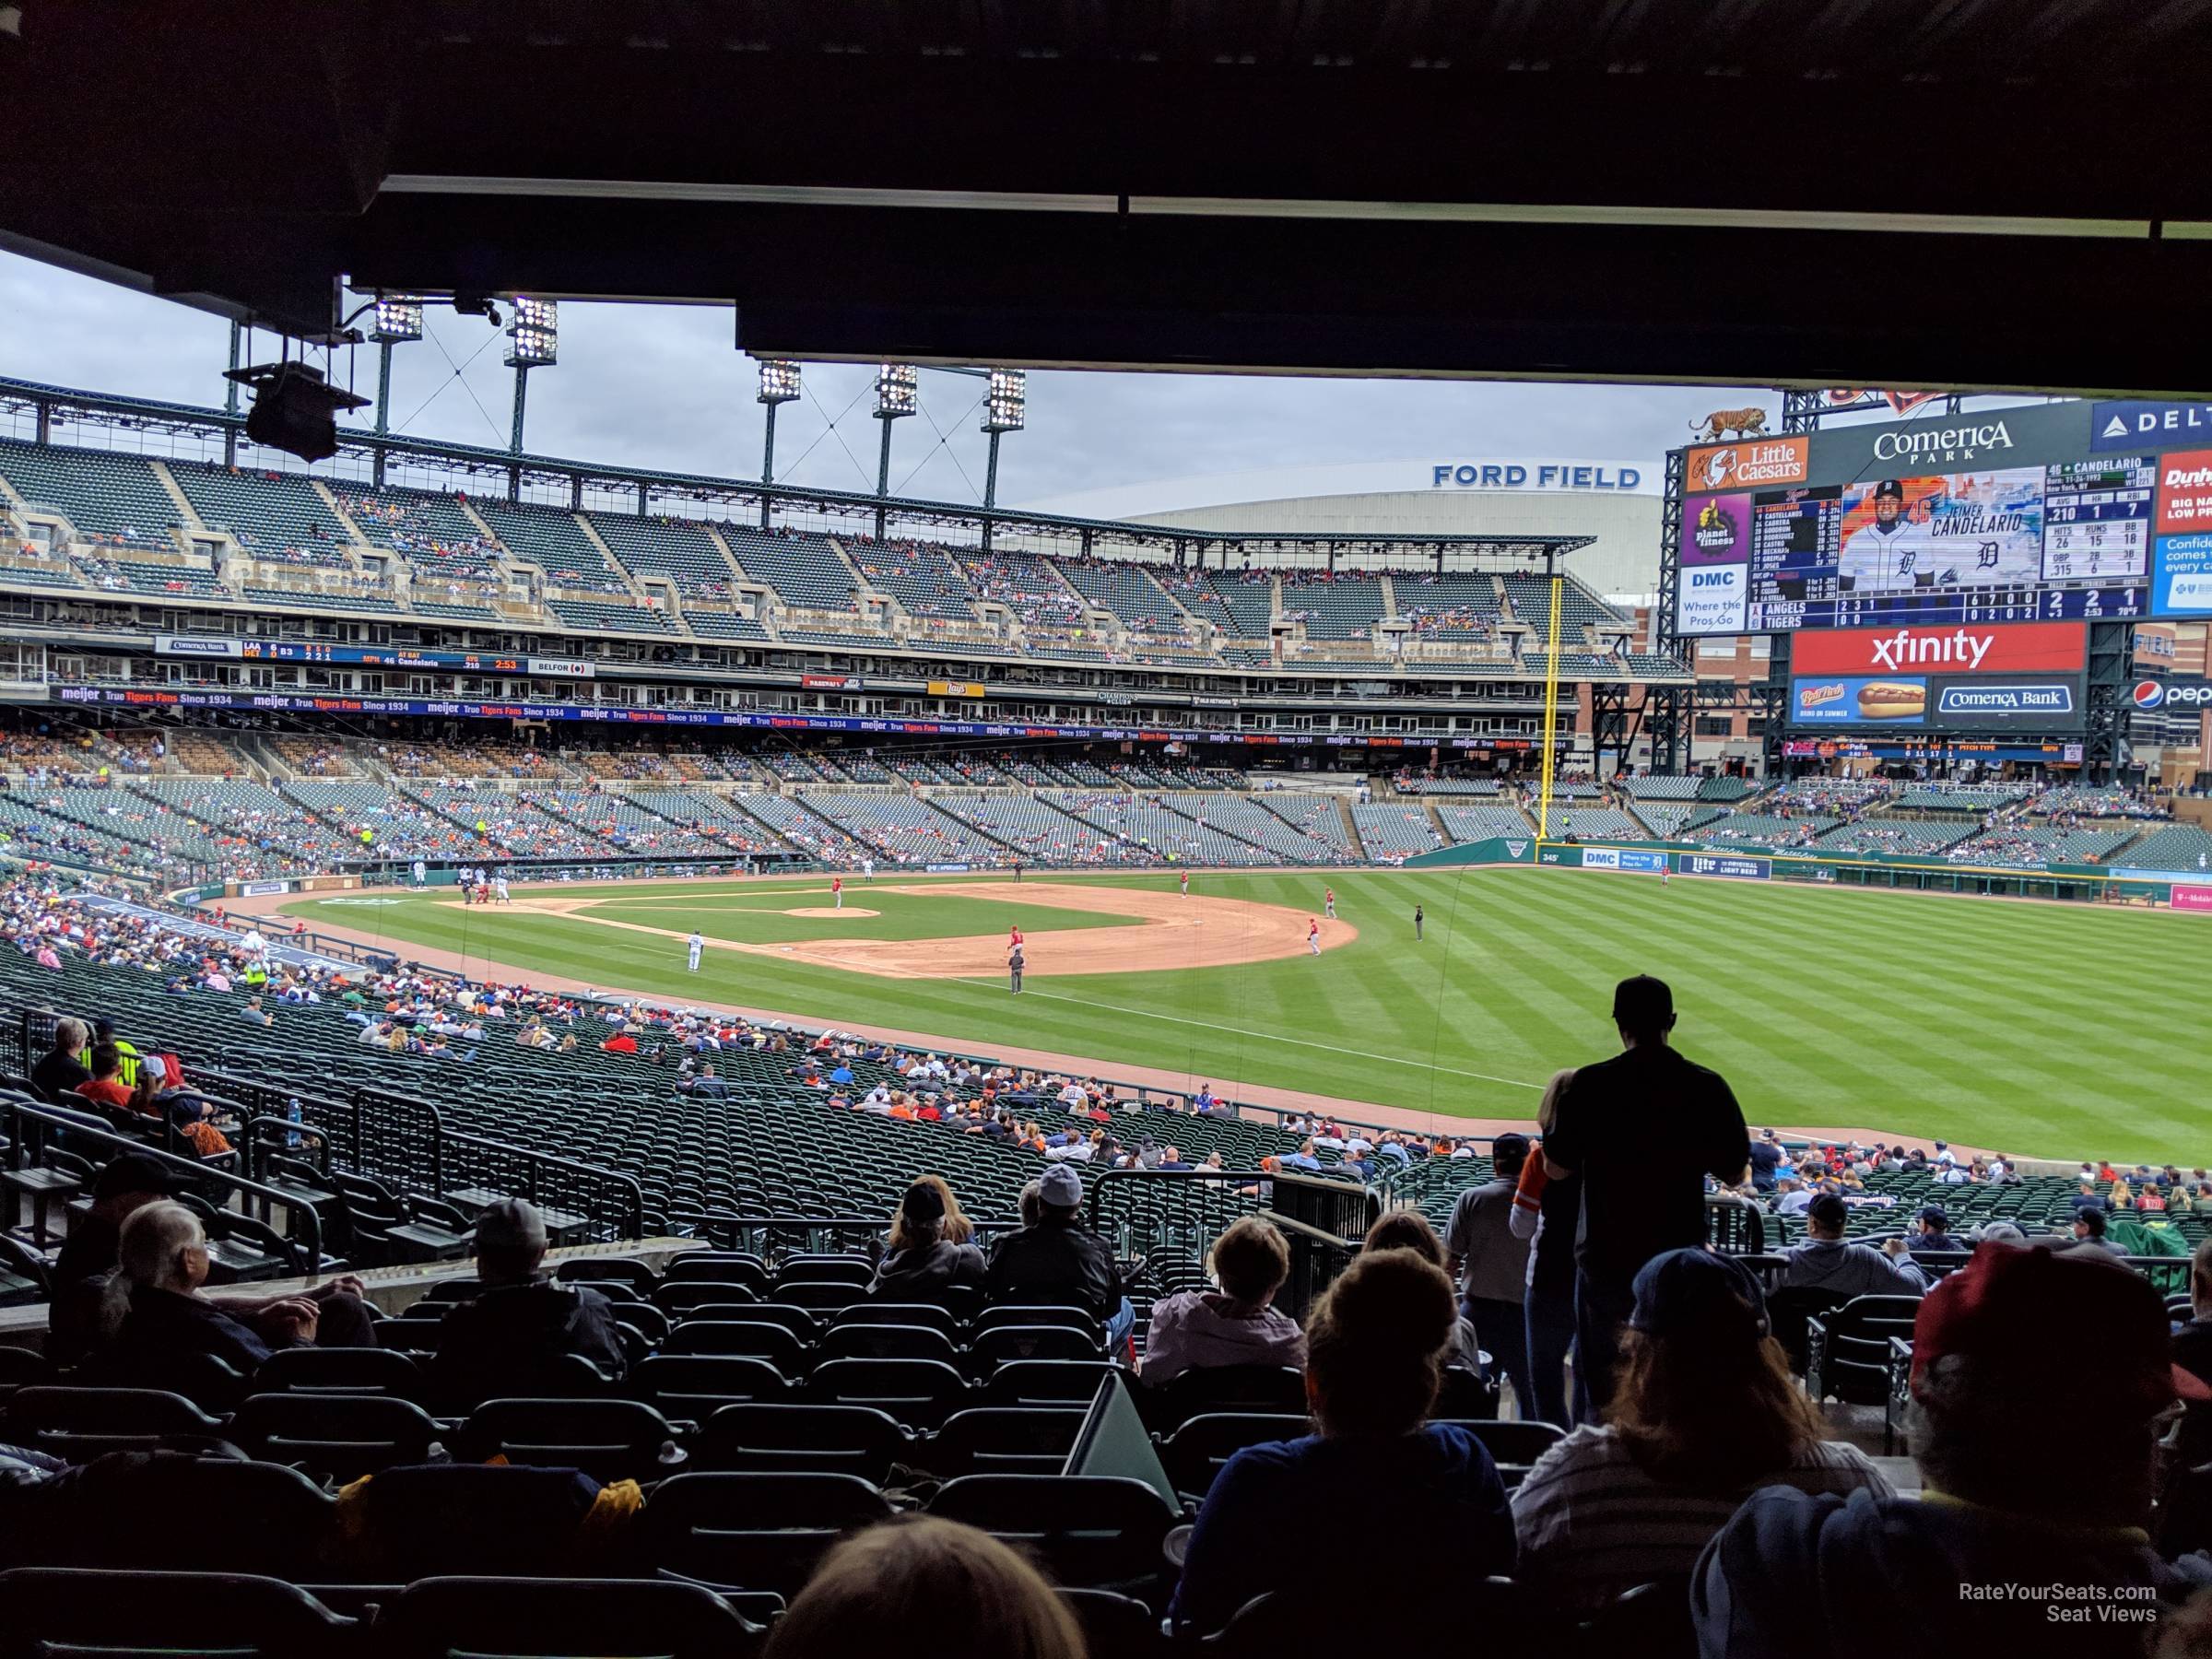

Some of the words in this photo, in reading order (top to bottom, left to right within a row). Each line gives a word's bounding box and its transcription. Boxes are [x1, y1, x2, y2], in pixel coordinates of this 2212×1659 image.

[1751, 443, 1794, 465] Little
[1910, 450, 1974, 465] PARK
[1737, 462, 1801, 481] Caesars
[2049, 465, 2062, 475] 46
[2075, 458, 2141, 473] CANDELARIO
[1433, 465, 1527, 488] FORD
[1537, 465, 1641, 490] FIELD
[2171, 499, 2193, 508] BIG
[1908, 500, 1931, 525] 46
[1947, 505, 1983, 519] JEIMER
[2048, 507, 2077, 522] .210
[2093, 505, 2100, 518] 1
[2129, 502, 2137, 516] 7
[2167, 509, 2194, 519] LOW
[1932, 513, 2022, 536] CANDELARIO
[2054, 526, 2072, 535] HITS
[2086, 524, 2107, 533] RUNS
[1696, 529, 1727, 542] planet
[1700, 536, 1735, 547] fitness
[2056, 538, 2069, 548] 26
[2090, 535, 2102, 546] 15
[2124, 534, 2136, 544] 18
[2053, 553, 2070, 562] OBP
[2124, 549, 2135, 558] 3B
[2166, 552, 2206, 560] comes
[2050, 565, 2072, 576] .315
[2091, 563, 2098, 573] 6
[2166, 563, 2199, 573] every
[1693, 571, 1735, 587] DMC
[1684, 602, 1719, 611] Where
[1723, 600, 1741, 609] the
[1766, 602, 1806, 615] ANGELS
[1841, 601, 1847, 611] 2
[1854, 600, 1861, 611] 3
[1870, 600, 1874, 610] 1
[1971, 595, 1978, 606] 6
[1989, 594, 1995, 605] 7
[2007, 594, 2014, 604] 0
[2025, 593, 2032, 604] 0
[2050, 592, 2063, 608] 2
[2086, 590, 2099, 607] 2
[2124, 589, 2135, 606] 1
[1766, 616, 1802, 628] TIGERS
[1841, 615, 1847, 625] 0
[1854, 615, 1860, 624] 0
[1971, 609, 1978, 620] 0
[1989, 608, 1995, 619] 2
[2006, 608, 2014, 618] 0
[2025, 607, 2031, 618] 2
[2056, 609, 2063, 618] 3
[2084, 608, 2102, 617] 2:53
[1689, 616, 1713, 626] Pros
[244, 642, 261, 651] LAA
[1871, 629, 1994, 670] xfinity
[398, 658, 438, 666] Candelario
[495, 660, 516, 669] 2:53
[62, 688, 100, 702] meijer
[106, 691, 124, 700] True
[126, 693, 154, 703] Tigers
[156, 694, 178, 702] Fans
[180, 695, 206, 703] Since
[208, 696, 231, 704] 1934
[2022, 691, 2061, 705] Bank
[253, 695, 288, 708] meijer
[295, 699, 312, 707] True
[314, 700, 339, 709] Tigers
[342, 700, 360, 709] Fans
[363, 701, 385, 710] Since
[389, 702, 408, 712] 1934
[428, 702, 458, 715] meijer
[465, 705, 479, 713] True
[481, 706, 503, 715] Tigers
[505, 707, 522, 715] Fans
[524, 708, 543, 716] Since
[546, 709, 564, 717] 1934
[581, 709, 608, 720] meijer
[613, 711, 627, 720] True
[628, 712, 647, 721] Tigers
[666, 713, 686, 722] Since
[689, 714, 707, 723] 1934
[724, 714, 751, 726] meijer
[756, 717, 770, 725] True
[771, 718, 792, 726] Tigers
[1586, 853, 1615, 864] DMC
[1692, 856, 1715, 872] Lite
[1727, 861, 1758, 869] ORIGINAL
[1947, 857, 2047, 870] MotorCityCasino.com
